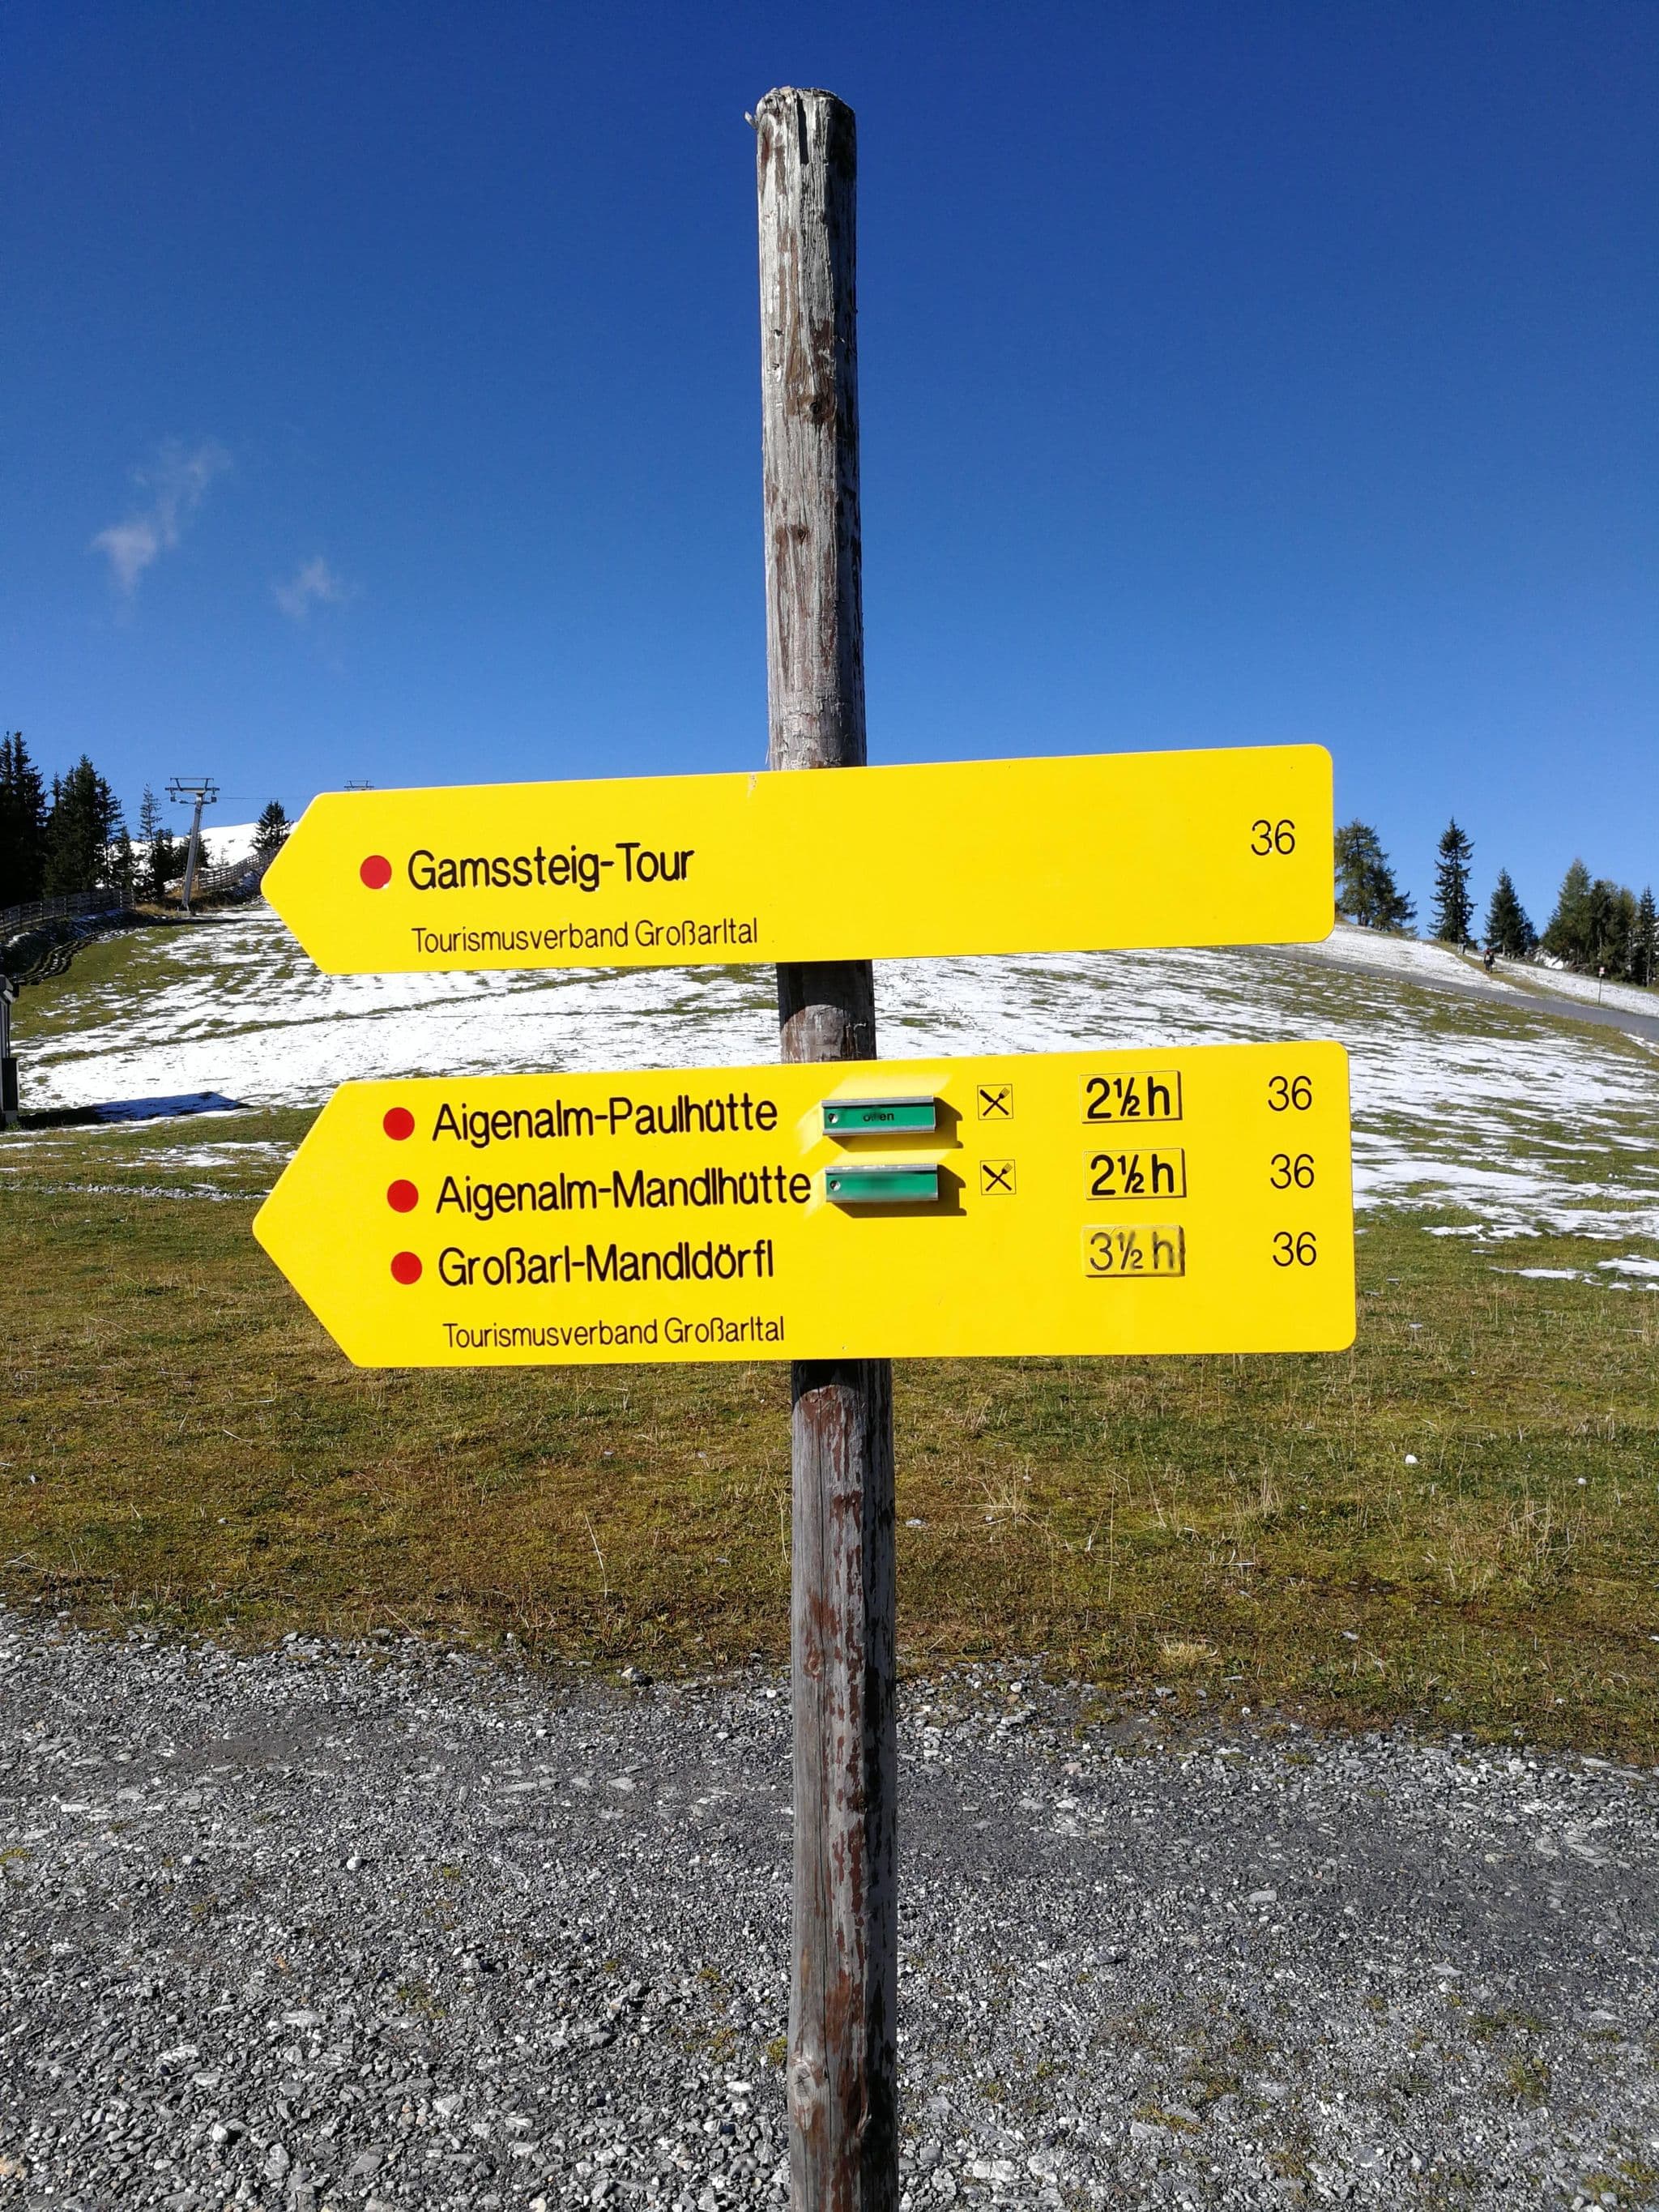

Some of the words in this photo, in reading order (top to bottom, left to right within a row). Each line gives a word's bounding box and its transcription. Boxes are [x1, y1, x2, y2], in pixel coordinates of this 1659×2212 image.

[1251, 819, 1295, 856] 36
[407, 842, 695, 893] Gamssteig-Tour
[411, 922, 629, 954] Tourismusverband
[635, 917, 757, 947] Großarltal
[1268, 1075, 1312, 1112] 36
[432, 1092, 778, 1149] Aigenalm-Paulhütte
[863, 1111, 894, 1121] oen
[1270, 1153, 1315, 1189] 36
[436, 1165, 812, 1221] Aigenalm-Mandlhütte
[438, 1239, 774, 1287] Großarl-Mandldörfl
[1273, 1231, 1317, 1267] 36
[442, 1318, 658, 1348] Tourismusverband
[664, 1315, 784, 1343] Großarltal
